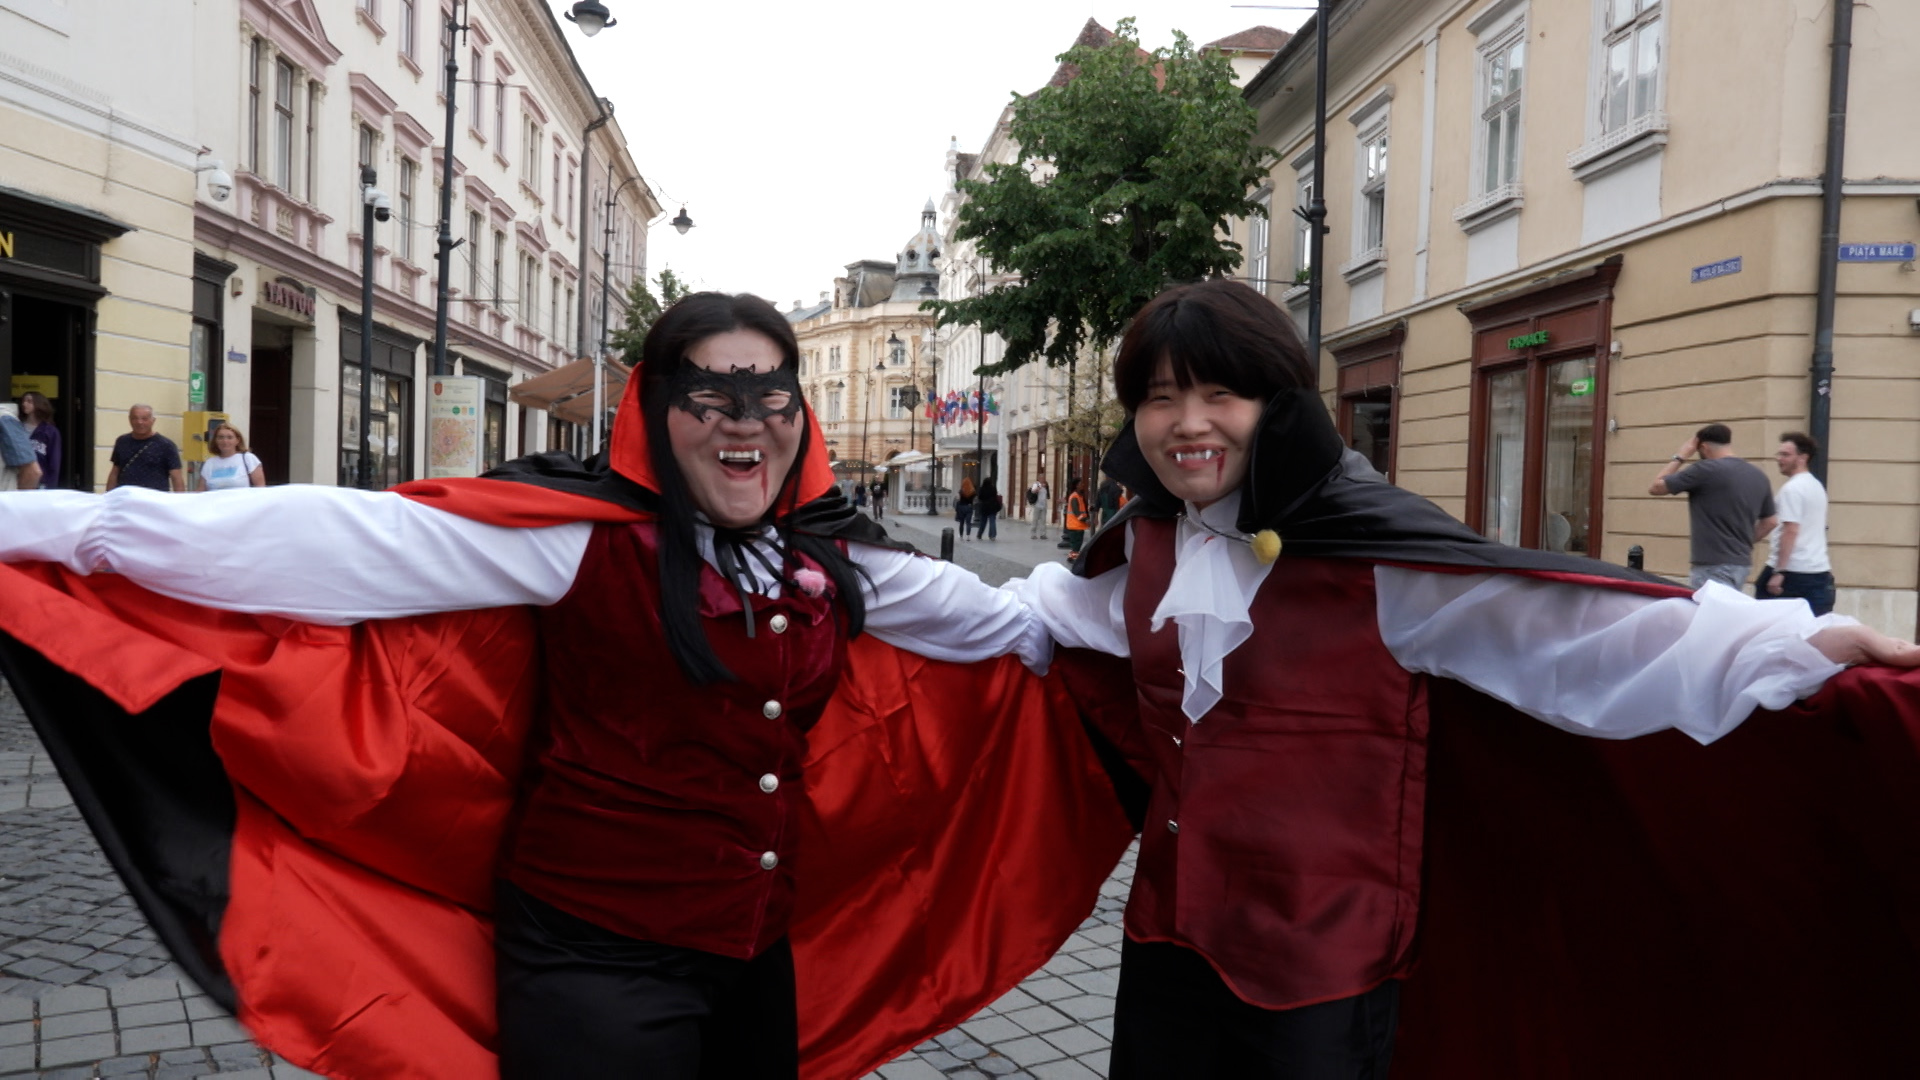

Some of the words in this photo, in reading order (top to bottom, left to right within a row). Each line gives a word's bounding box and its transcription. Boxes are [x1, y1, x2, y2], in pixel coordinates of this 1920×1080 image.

[1879, 246, 1905, 256] MARE
[263, 280, 316, 318] TATTOO
[1507, 330, 1548, 350] FARMACIE
